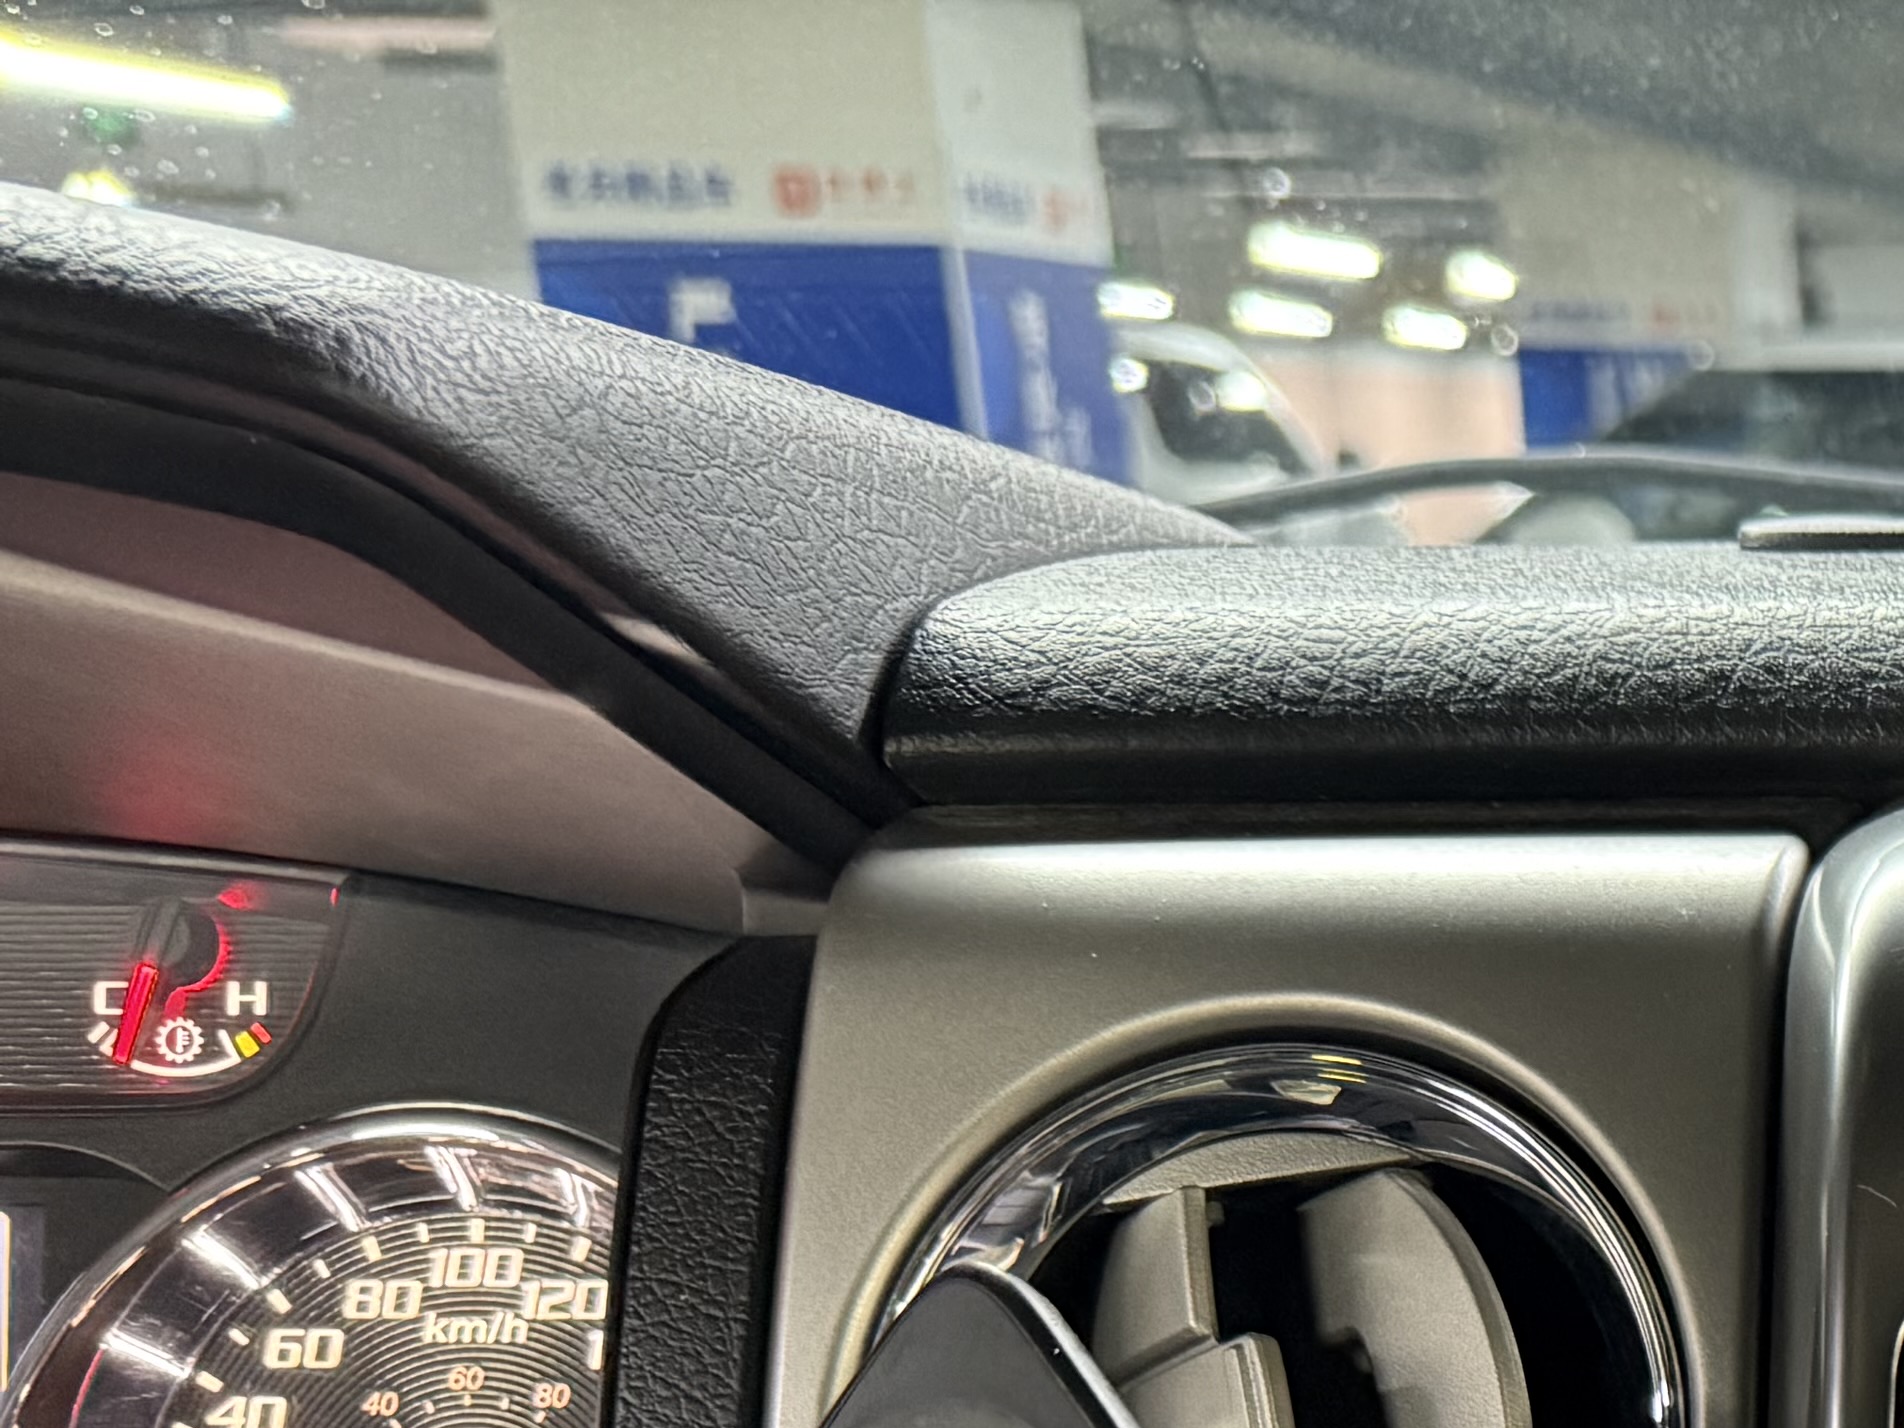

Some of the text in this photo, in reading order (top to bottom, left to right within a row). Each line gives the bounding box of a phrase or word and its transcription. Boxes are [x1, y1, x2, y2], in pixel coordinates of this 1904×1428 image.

[226, 981, 268, 1016] H
[428, 1247, 524, 1288] 100
[341, 1279, 423, 1320] 80
[522, 1279, 609, 1321] 120
[422, 1311, 529, 1344] km/h
[263, 1327, 345, 1369] 60
[448, 1365, 486, 1391] 60
[361, 1391, 399, 1417] 40
[532, 1383, 571, 1409] 80
